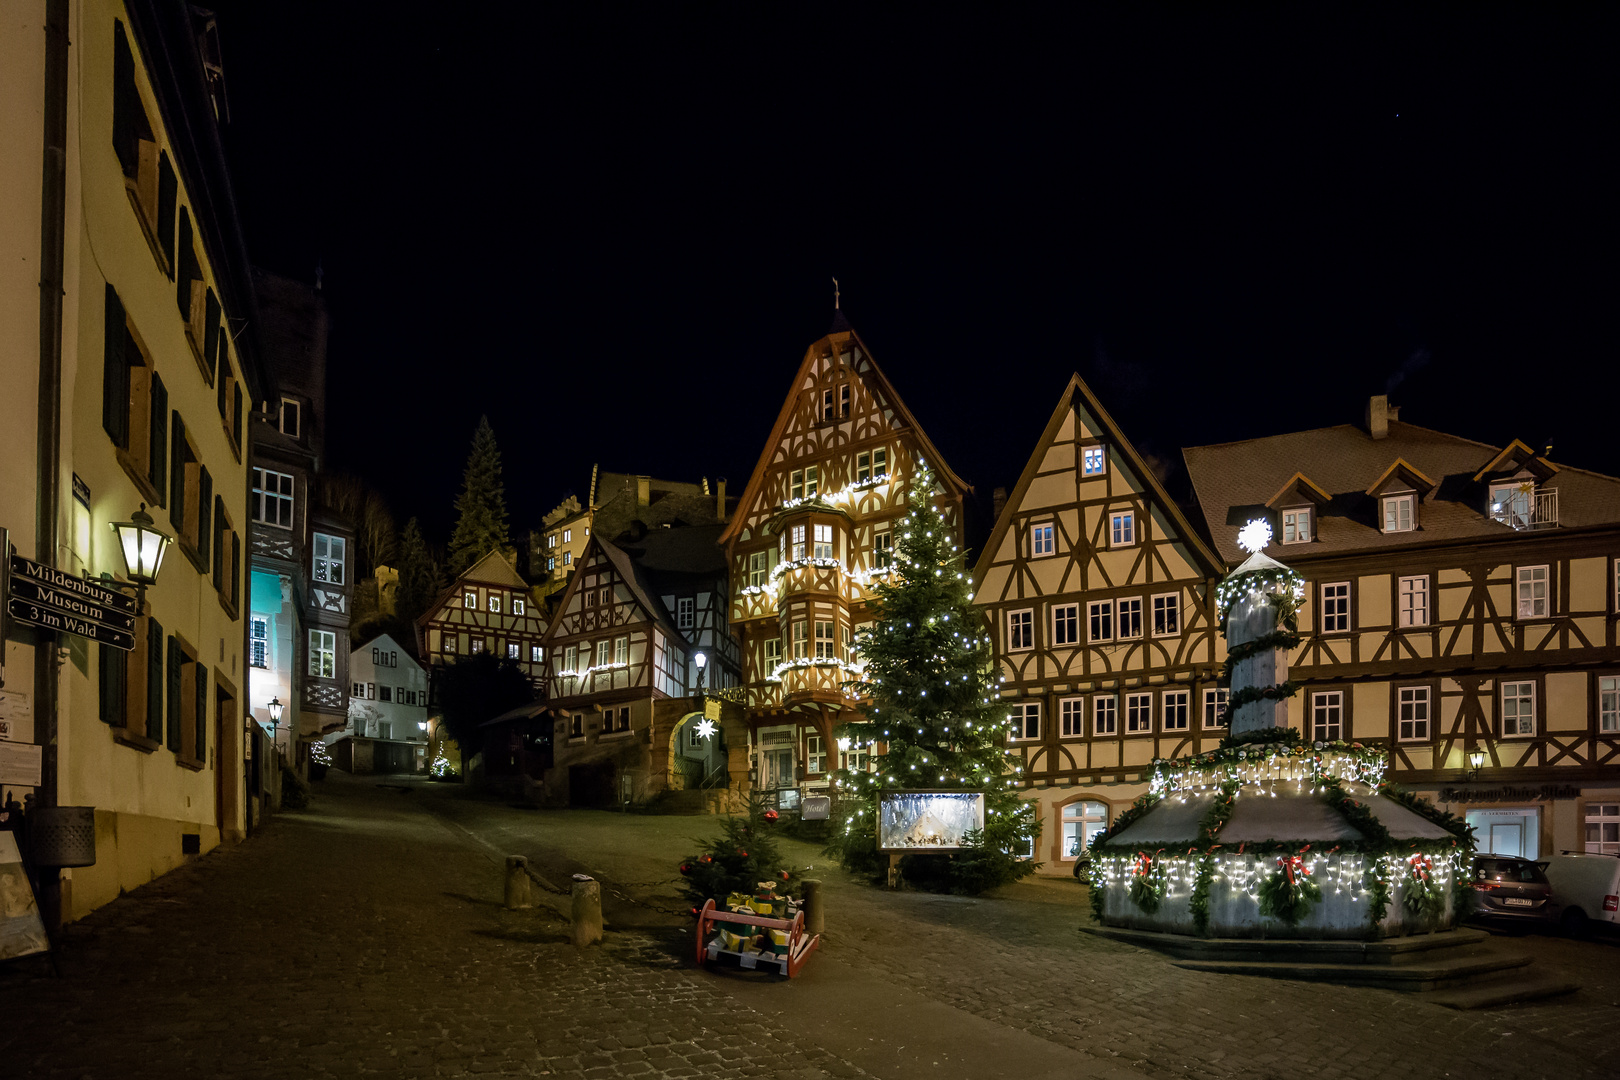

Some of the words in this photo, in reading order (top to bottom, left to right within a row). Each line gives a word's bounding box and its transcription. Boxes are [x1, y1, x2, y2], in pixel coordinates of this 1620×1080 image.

[26, 561, 113, 605] Mildenburg
[37, 587, 103, 619] Museum
[30, 607, 39, 619] 3
[42, 611, 60, 627] im
[64, 617, 97, 637] Wald
[805, 803, 827, 813] Hotel
